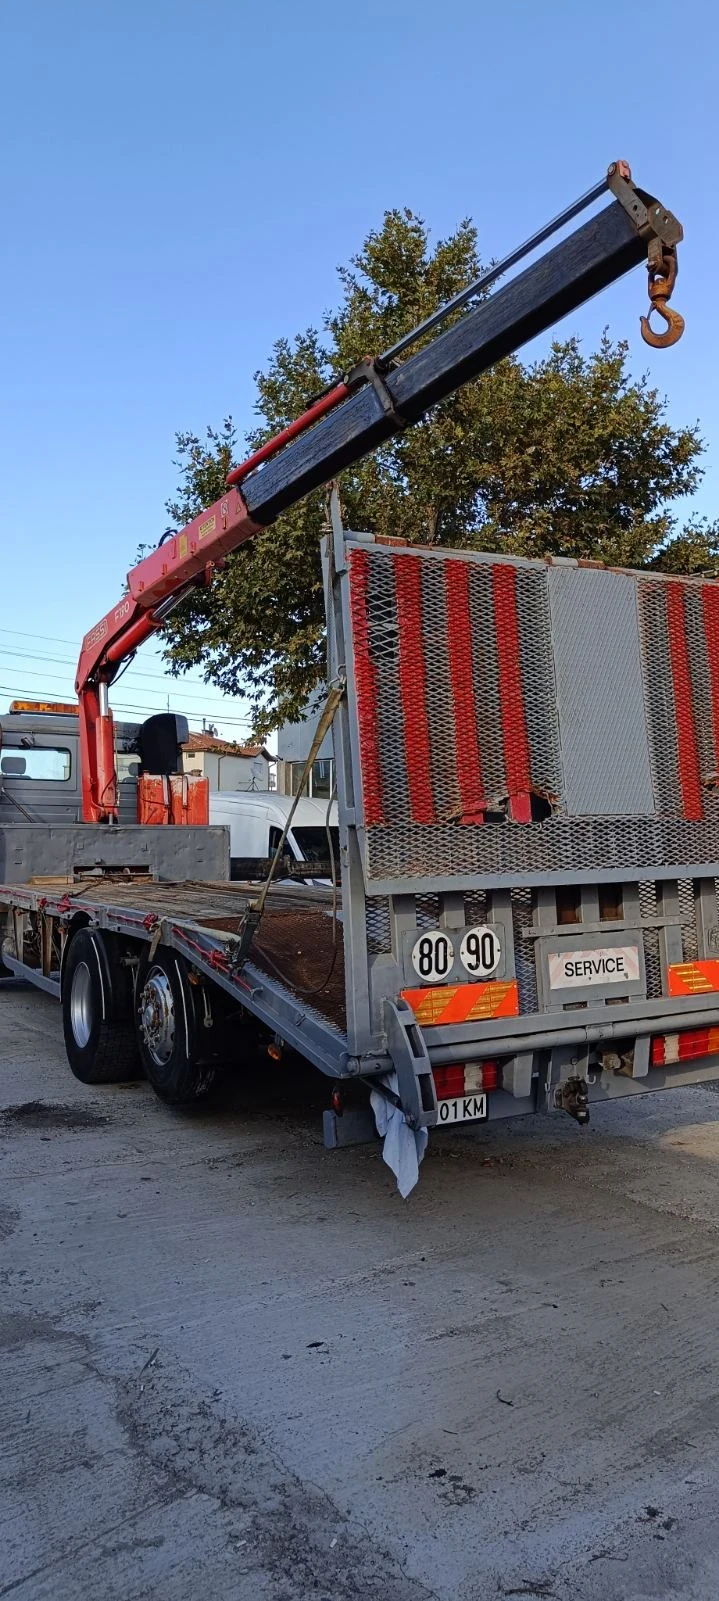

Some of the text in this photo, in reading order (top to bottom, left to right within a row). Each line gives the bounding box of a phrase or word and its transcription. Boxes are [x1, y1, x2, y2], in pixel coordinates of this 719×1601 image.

[419, 937, 448, 976] 80
[467, 932, 494, 971] 90
[564, 957, 624, 977] SERVICE
[463, 1096, 483, 1118] KM
